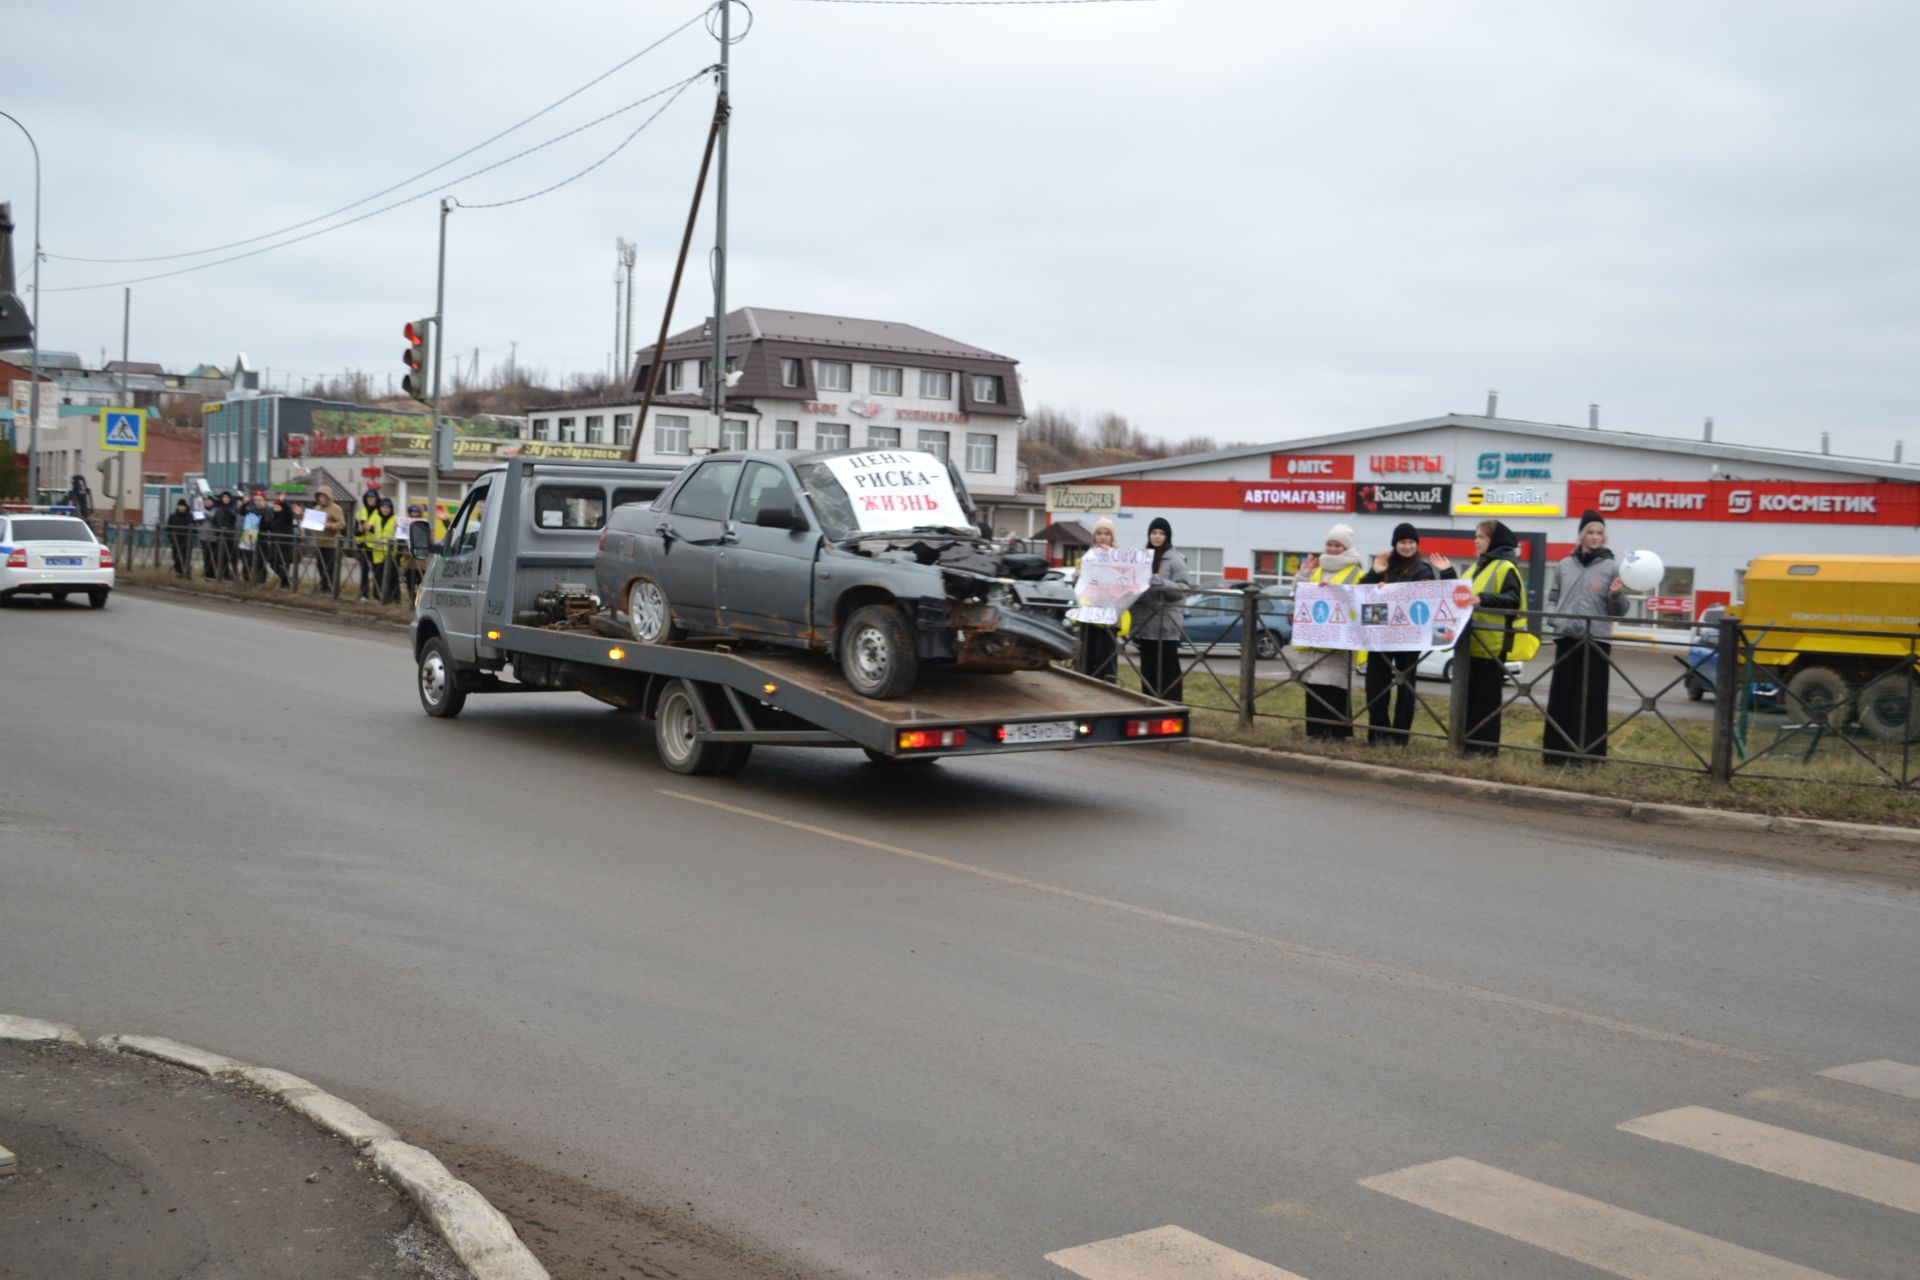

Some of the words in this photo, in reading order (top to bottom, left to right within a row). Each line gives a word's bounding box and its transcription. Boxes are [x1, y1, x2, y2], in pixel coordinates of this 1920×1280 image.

[525, 441, 621, 460] Продукты
[1505, 453, 1553, 464] МАГНИТ
[849, 453, 911, 469] ЦЕНА
[1298, 460, 1334, 474] МТС
[1370, 455, 1442, 475] ЦВЕТЫ
[1505, 468, 1553, 479] АПТЕКА
[859, 494, 940, 512] ЖИЗНЬ
[1053, 486, 1115, 512] Пекарня
[1244, 489, 1346, 505] АВТОМАГАЗИН
[1374, 485, 1443, 503] КамелиЯ
[1485, 487, 1545, 505] билайн
[1626, 492, 1707, 510] МАГНИТ
[1758, 494, 1877, 513] КОСМЕТИК
